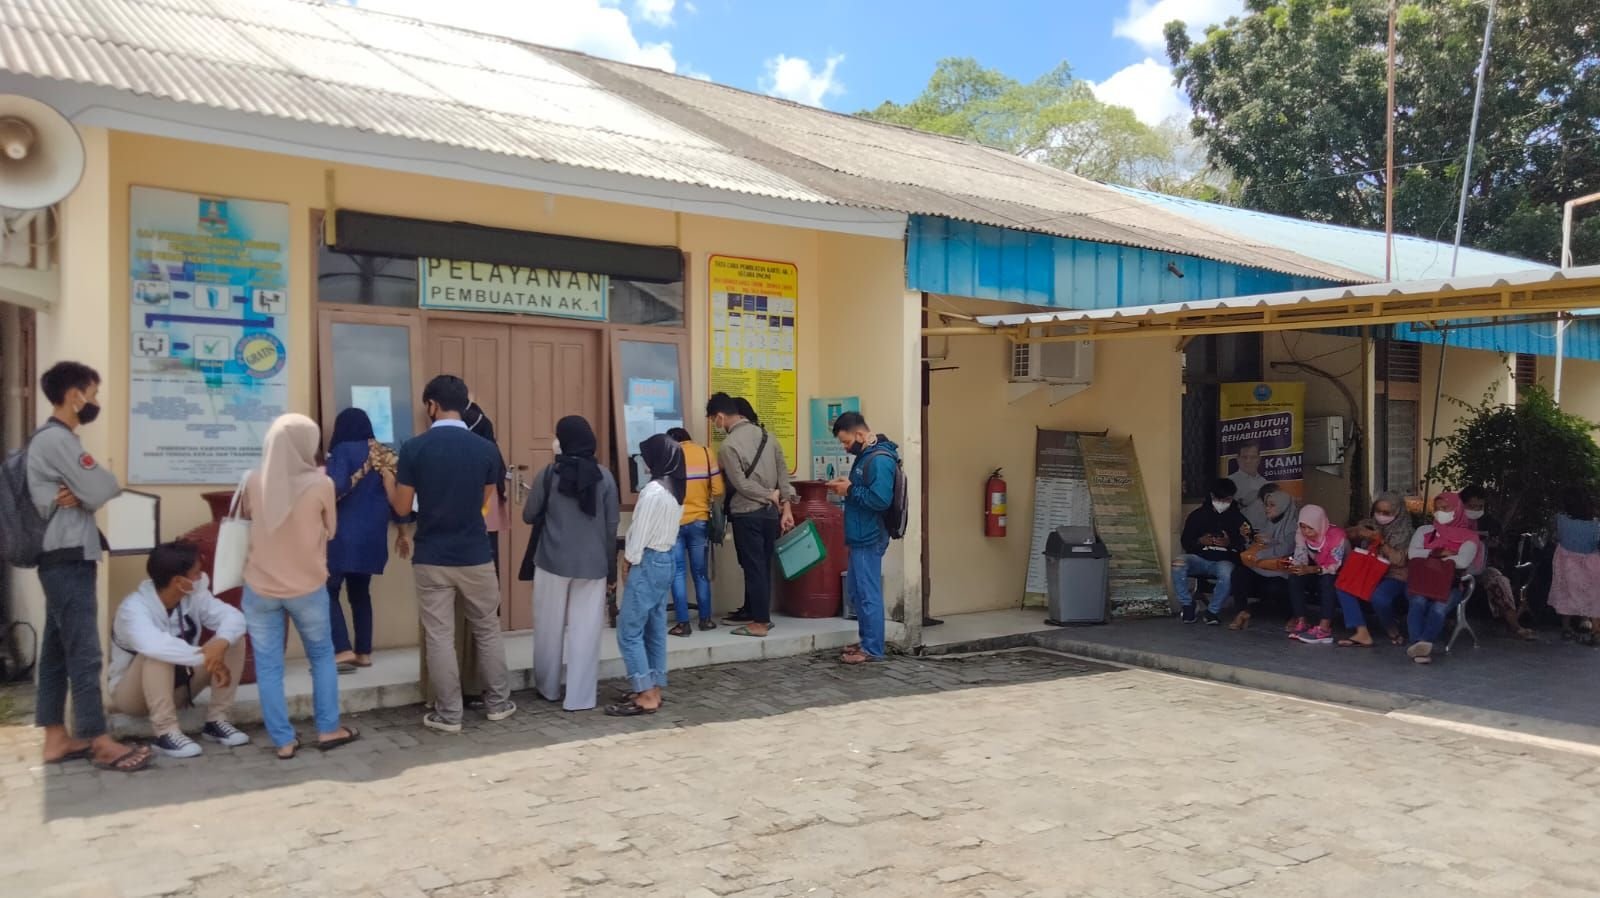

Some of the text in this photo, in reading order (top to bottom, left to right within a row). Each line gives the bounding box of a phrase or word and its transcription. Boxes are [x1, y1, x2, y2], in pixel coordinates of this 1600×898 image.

[428, 258, 601, 292] PELAYANAN
[431, 286, 551, 308] PEMBUATAN
[246, 345, 275, 365] GRATIS
[1221, 417, 1288, 433] ANDA BUTUH
[1221, 429, 1281, 443] REHABILITASI
[1265, 455, 1302, 469] KAMI
